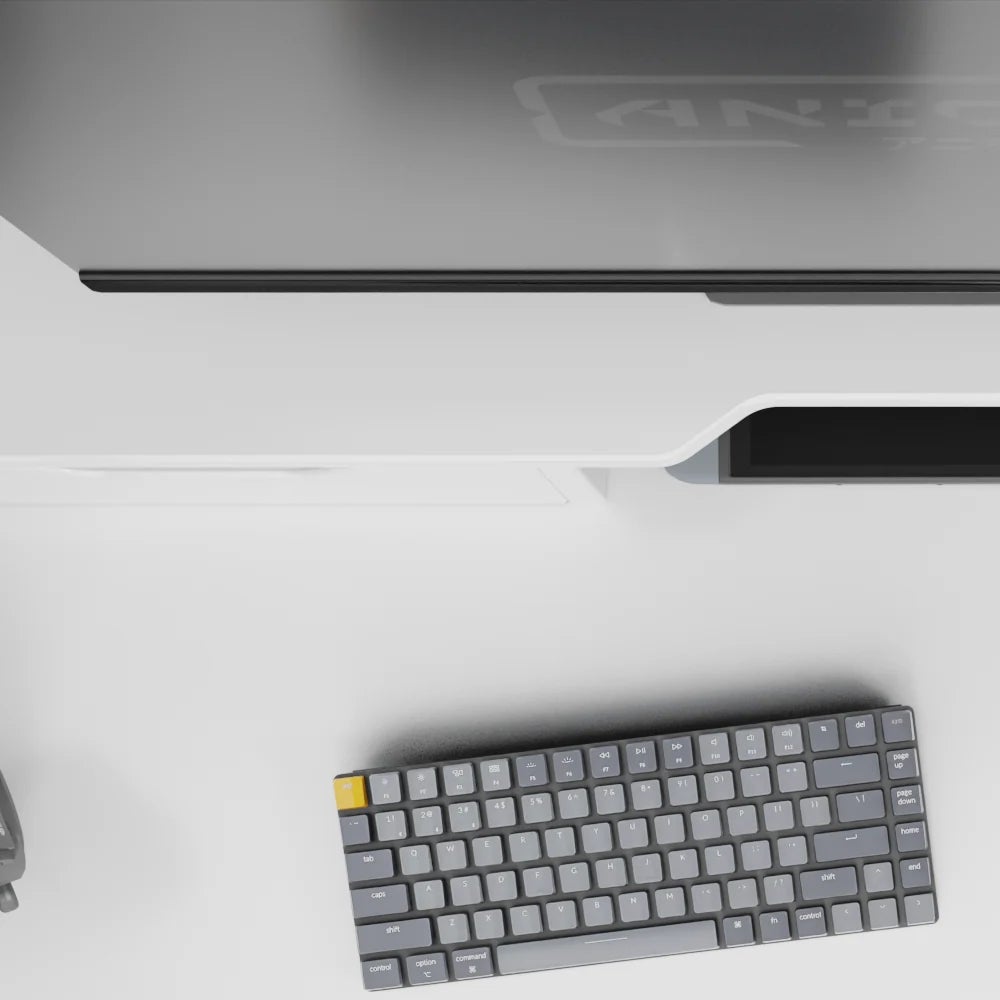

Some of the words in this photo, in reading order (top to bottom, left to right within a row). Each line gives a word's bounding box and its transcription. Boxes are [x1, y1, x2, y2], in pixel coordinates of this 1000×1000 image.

[855, 720, 866, 729] del
[892, 752, 910, 761] page
[896, 789, 913, 798] page
[897, 797, 917, 806] down
[900, 827, 920, 835] home
[362, 855, 375, 863] tab
[908, 862, 921, 871] end
[820, 872, 836, 882] shift
[370, 891, 386, 899] caps
[770, 916, 779, 925] fn
[798, 911, 822, 921] control
[385, 925, 401, 934] shift
[455, 951, 487, 963] command
[415, 958, 437, 968] option
[369, 963, 392, 973] control
